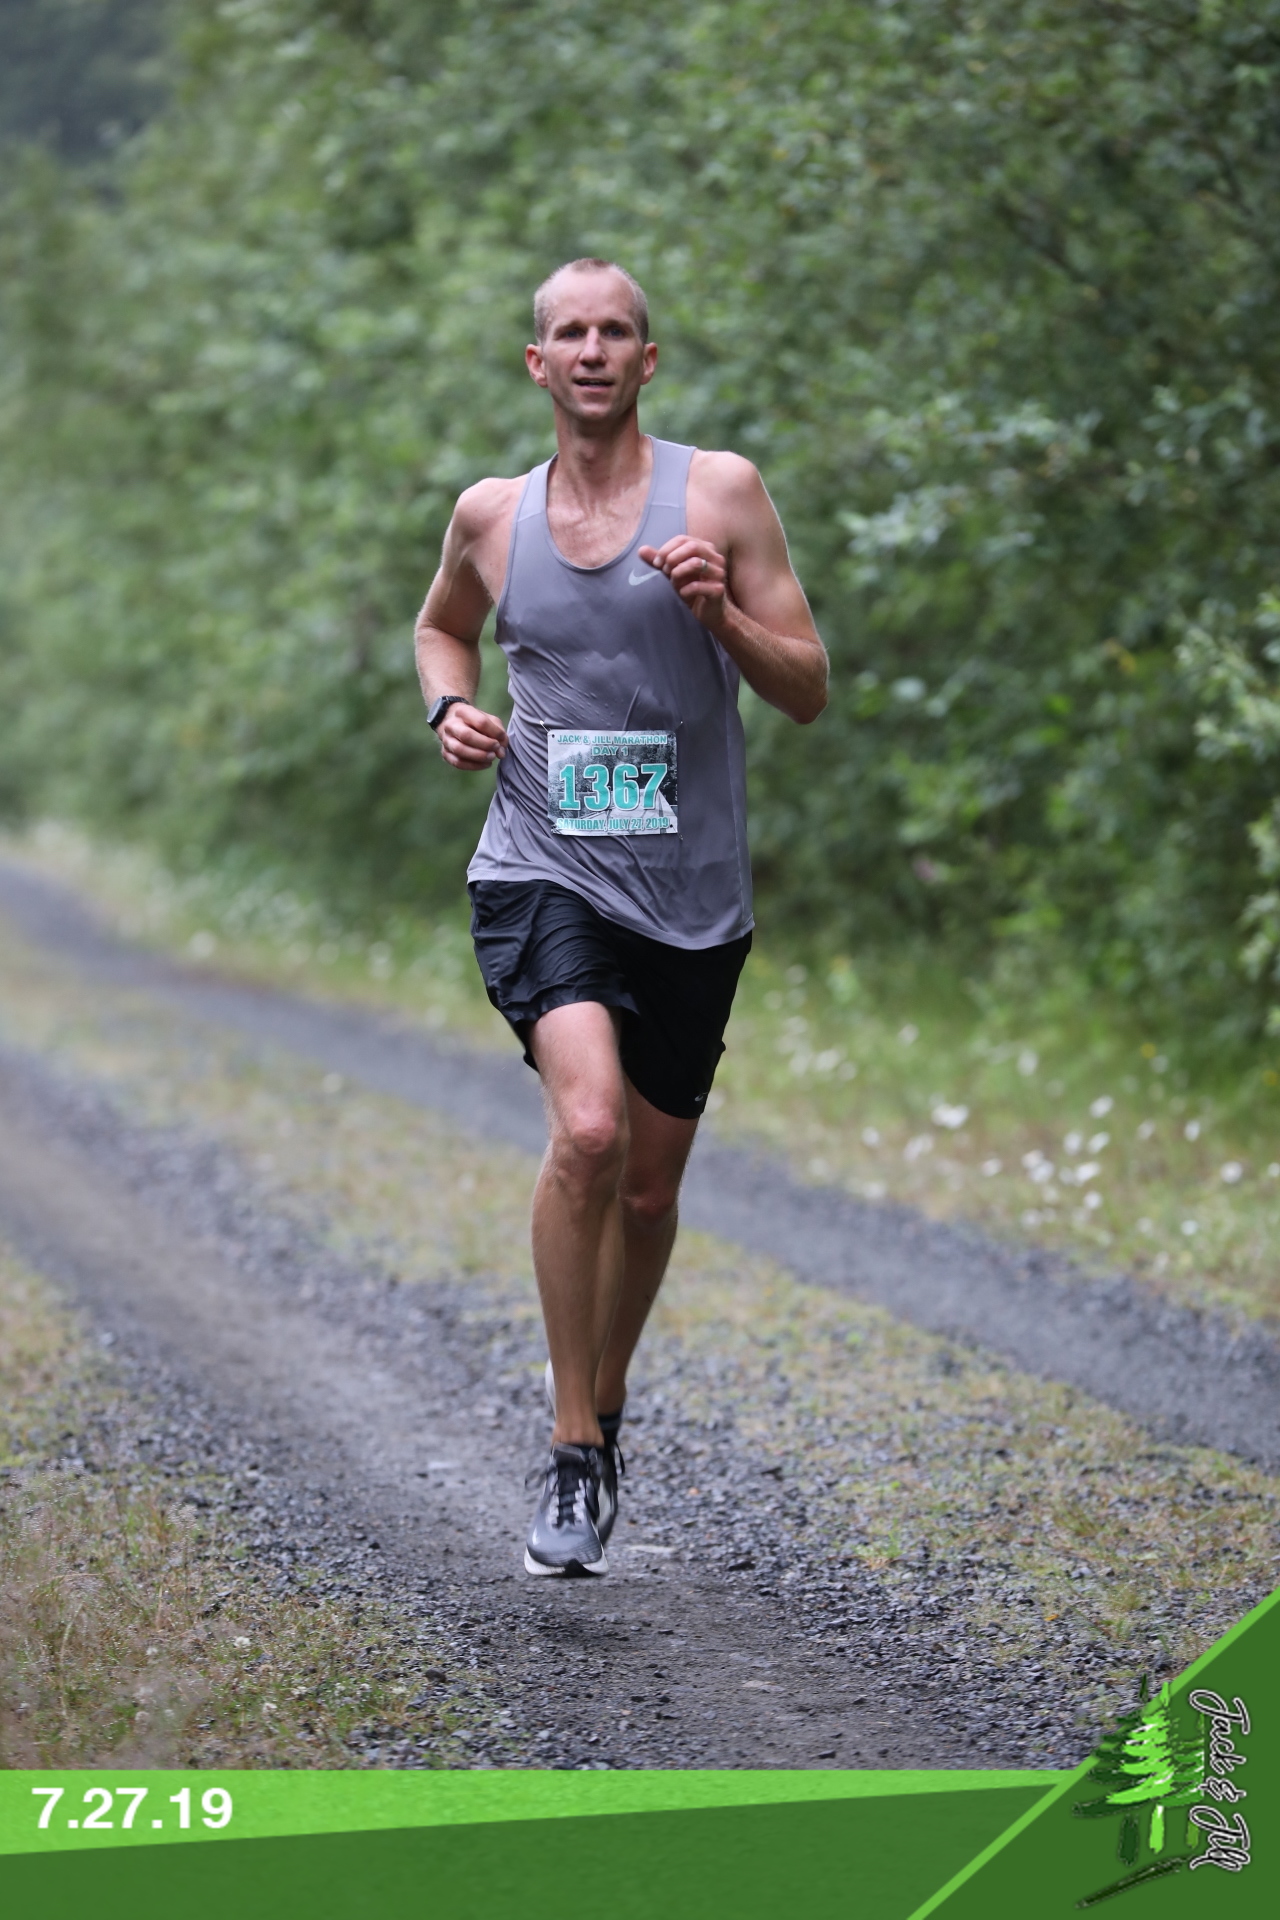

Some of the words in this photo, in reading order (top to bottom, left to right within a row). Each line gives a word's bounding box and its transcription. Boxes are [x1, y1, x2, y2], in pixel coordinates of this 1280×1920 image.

[557, 736, 580, 744] JACK
[583, 736, 589, 744] &
[592, 736, 611, 744] JILL
[614, 735, 667, 744] MARATHON
[592, 747, 618, 755] DAY
[621, 747, 629, 755] 1
[560, 764, 667, 811] 1367
[557, 818, 606, 830] SATURDAY,
[608, 818, 630, 830] JULY
[631, 818, 644, 830] 27,
[646, 817, 670, 829] 2019
